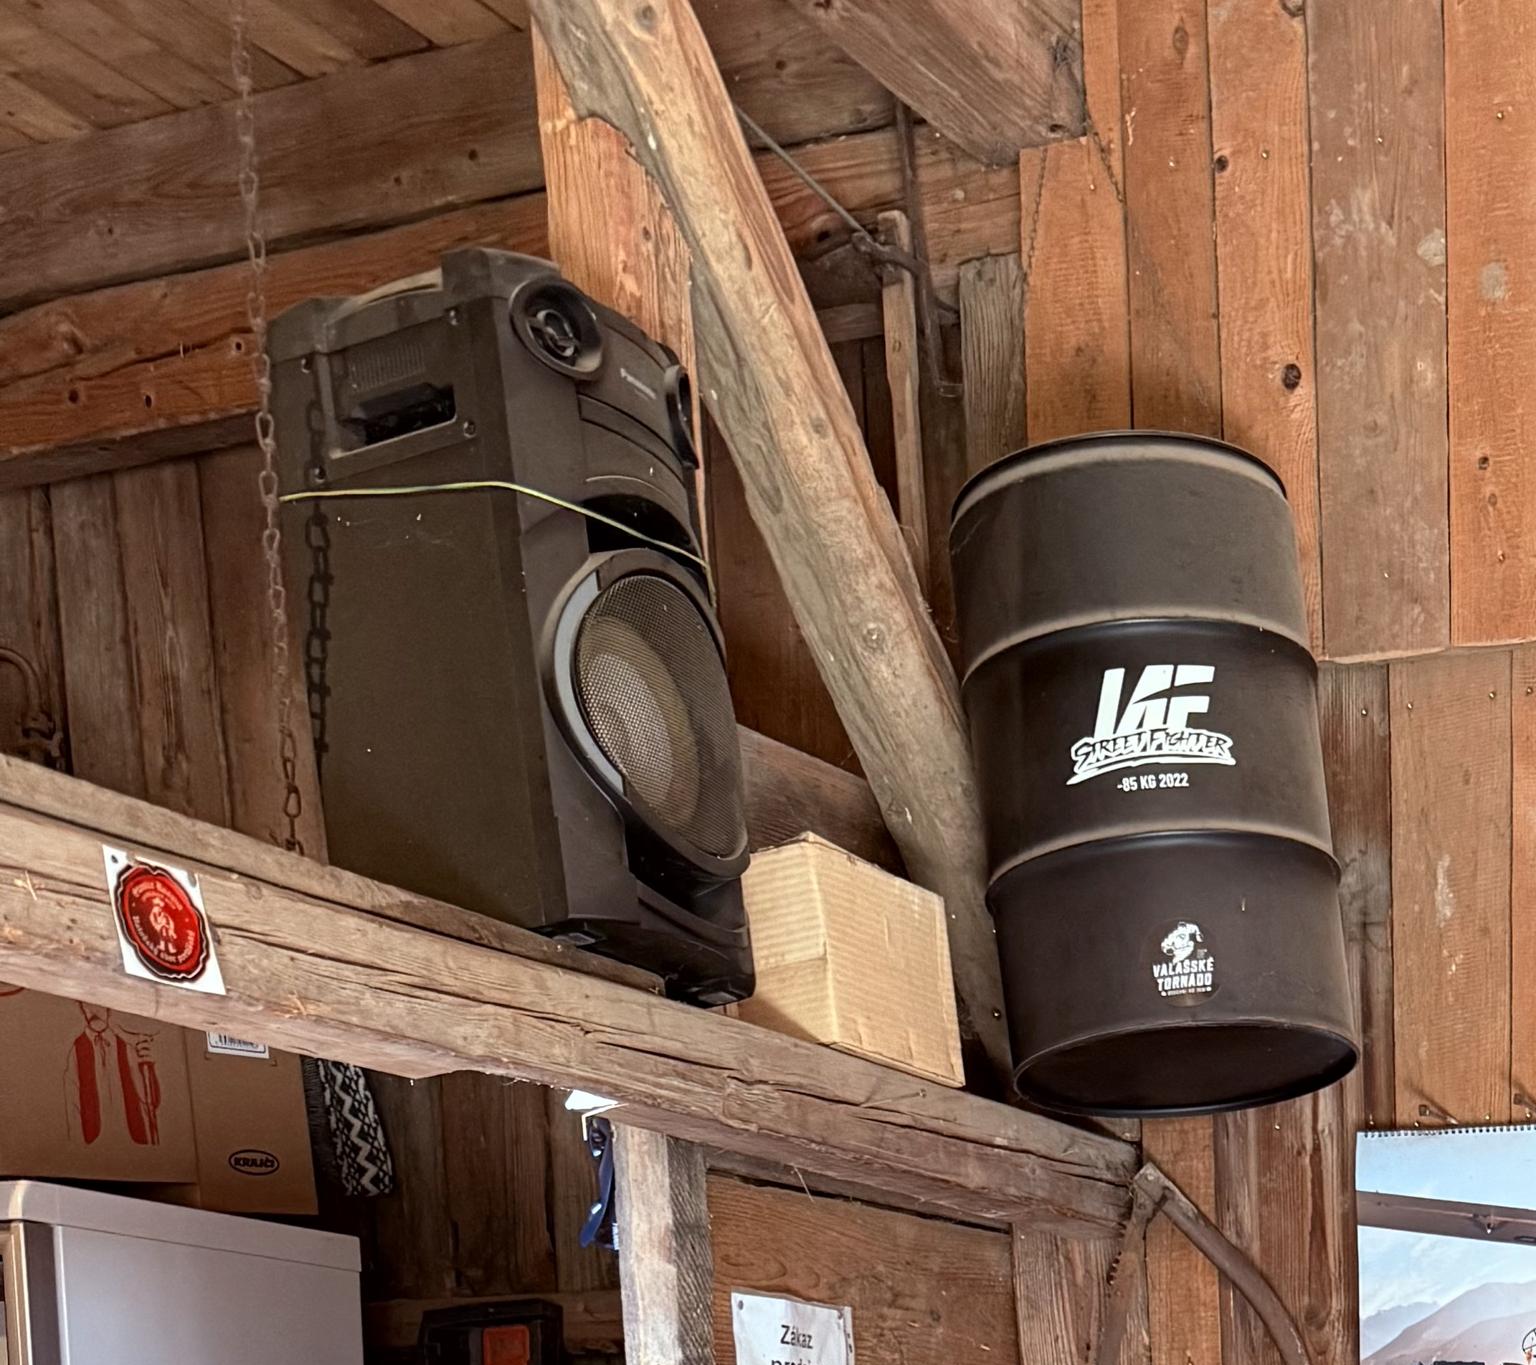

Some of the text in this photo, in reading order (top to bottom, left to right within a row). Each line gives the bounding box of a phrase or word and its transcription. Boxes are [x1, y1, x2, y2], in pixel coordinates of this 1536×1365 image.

[1116, 772, 1190, 792] -85 KG 2022
[780, 1324, 813, 1349] Zákaz
